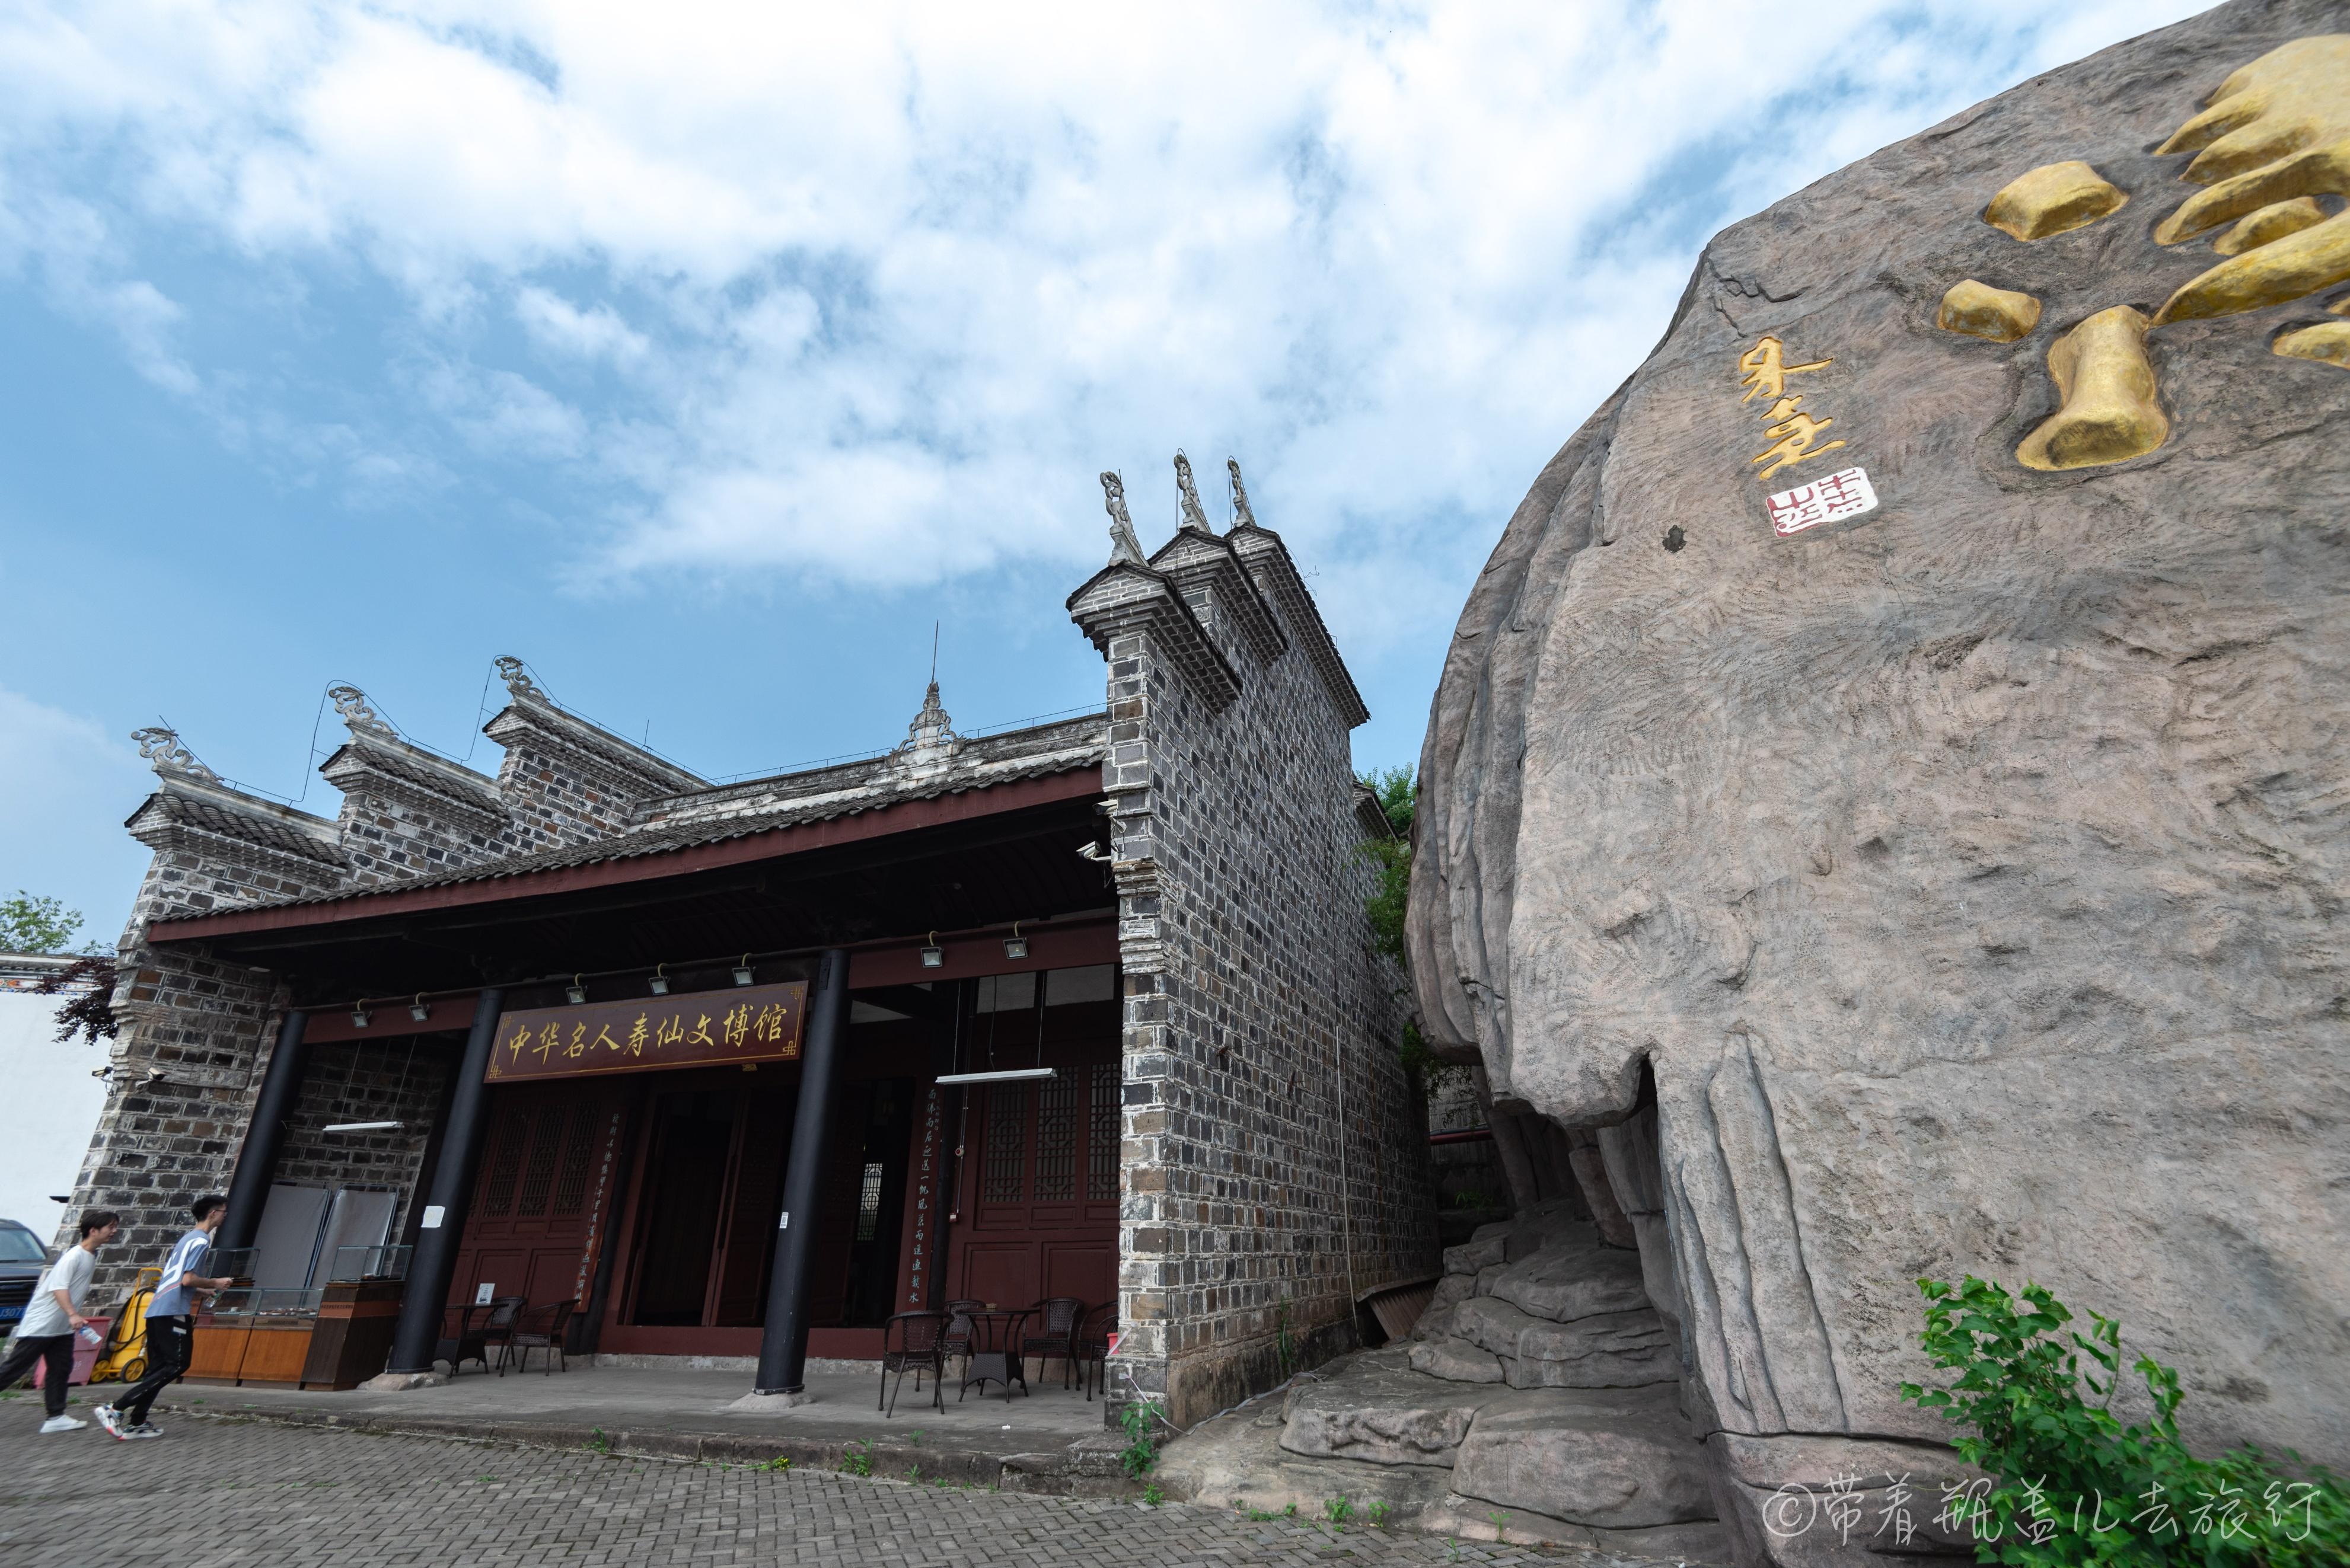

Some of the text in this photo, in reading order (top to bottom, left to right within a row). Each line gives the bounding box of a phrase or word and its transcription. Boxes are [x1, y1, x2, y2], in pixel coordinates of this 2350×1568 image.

[508, 1003, 787, 1066] 中华名人寿仙文博馆
